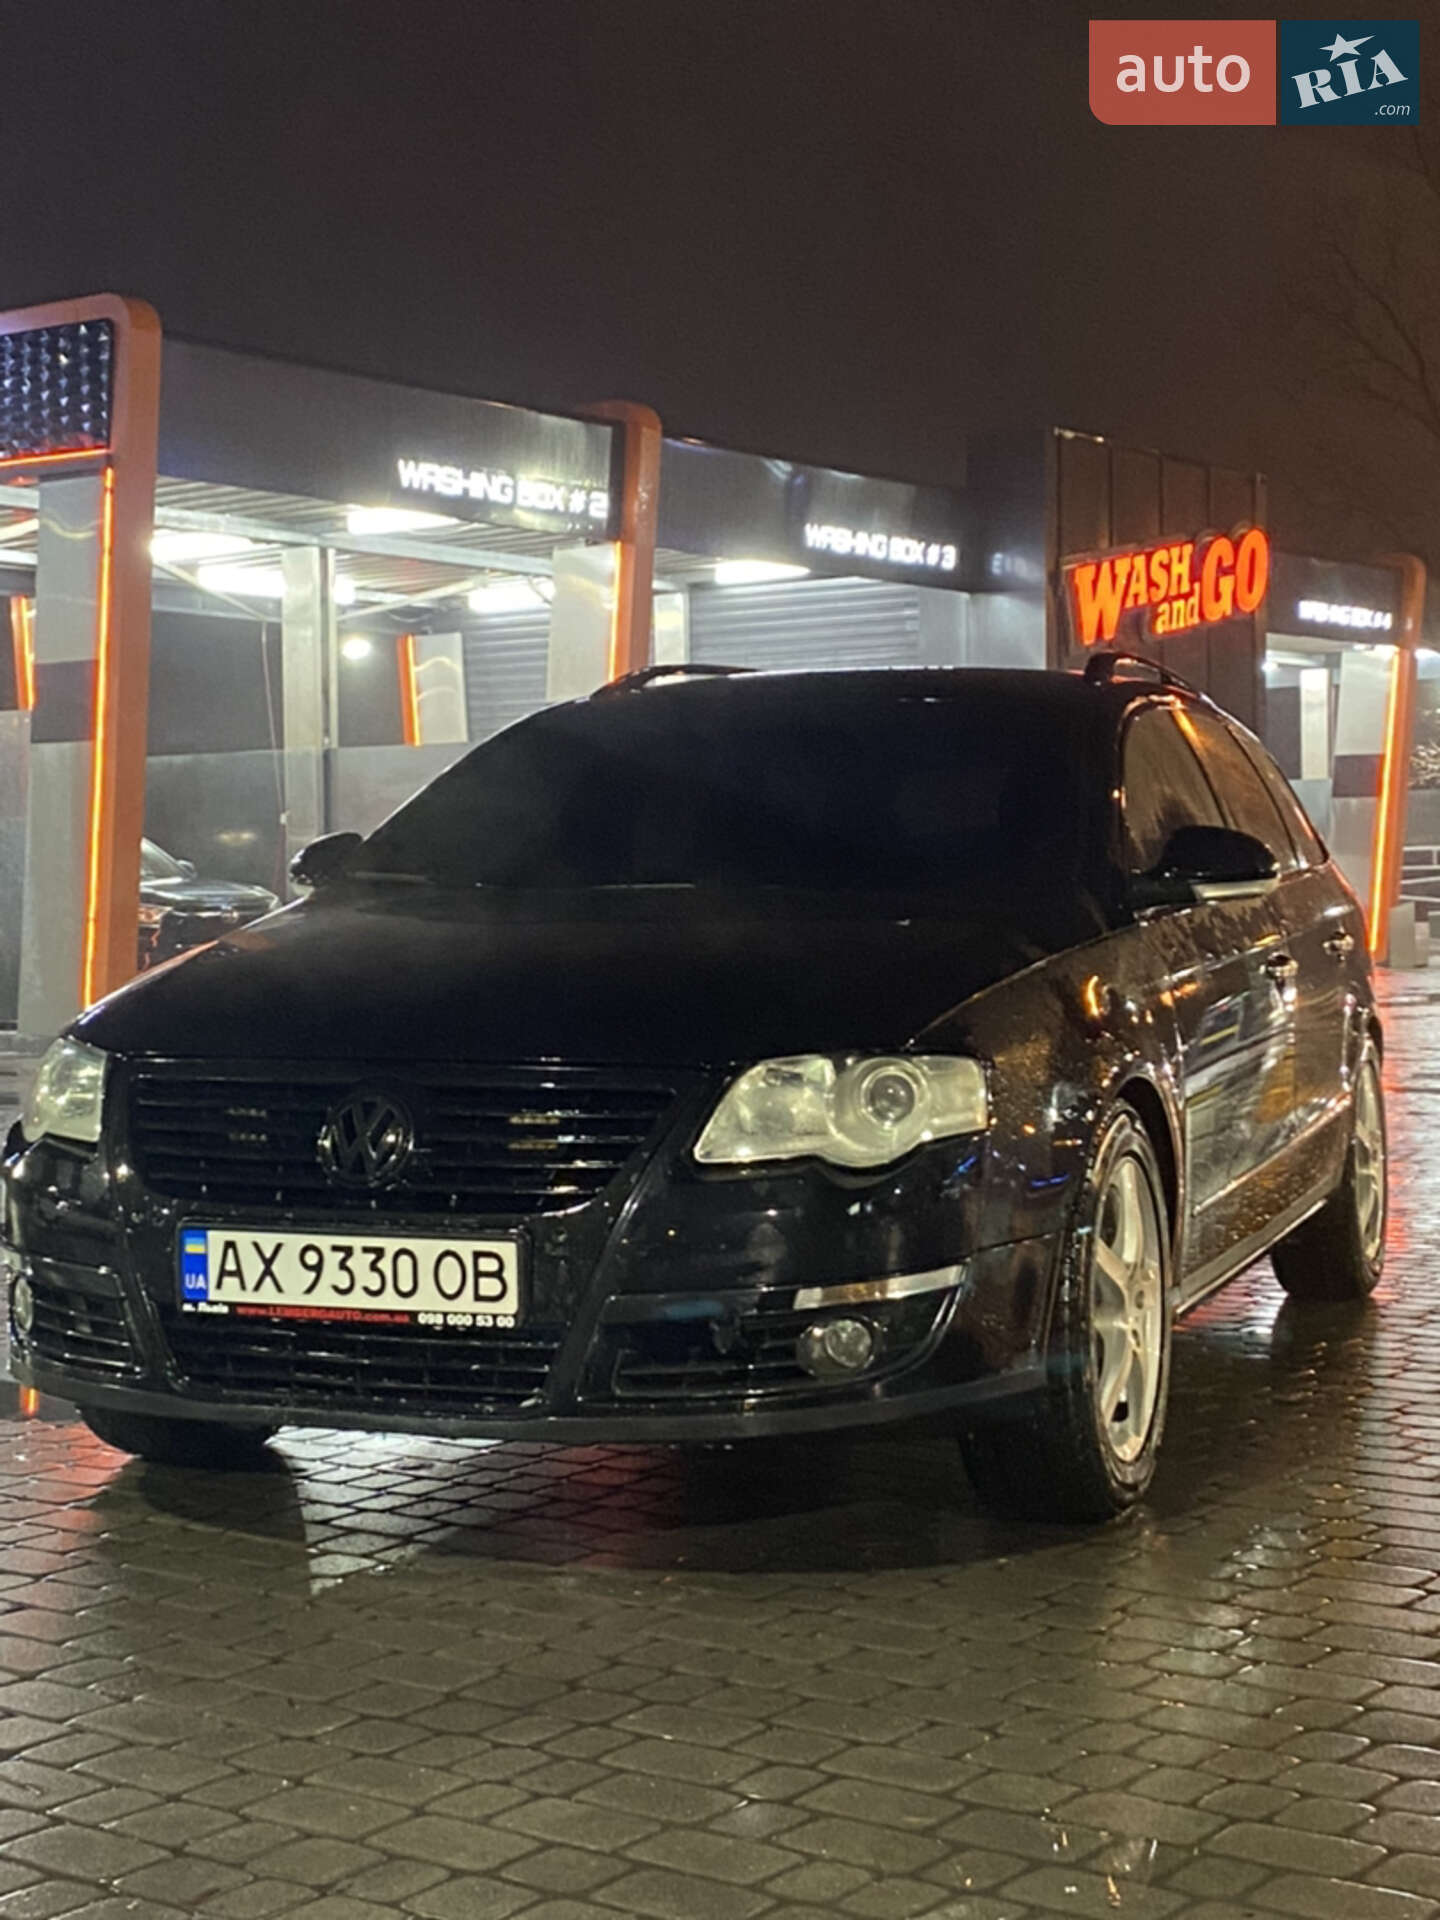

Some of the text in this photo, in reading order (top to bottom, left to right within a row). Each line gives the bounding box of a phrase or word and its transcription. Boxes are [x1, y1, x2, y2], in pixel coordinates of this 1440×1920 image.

[941, 545, 956, 569] 3
[1074, 528, 1270, 646] WASH and GO
[184, 1273, 207, 1290] UA
[216, 1240, 508, 1302] AX 9330 OB
